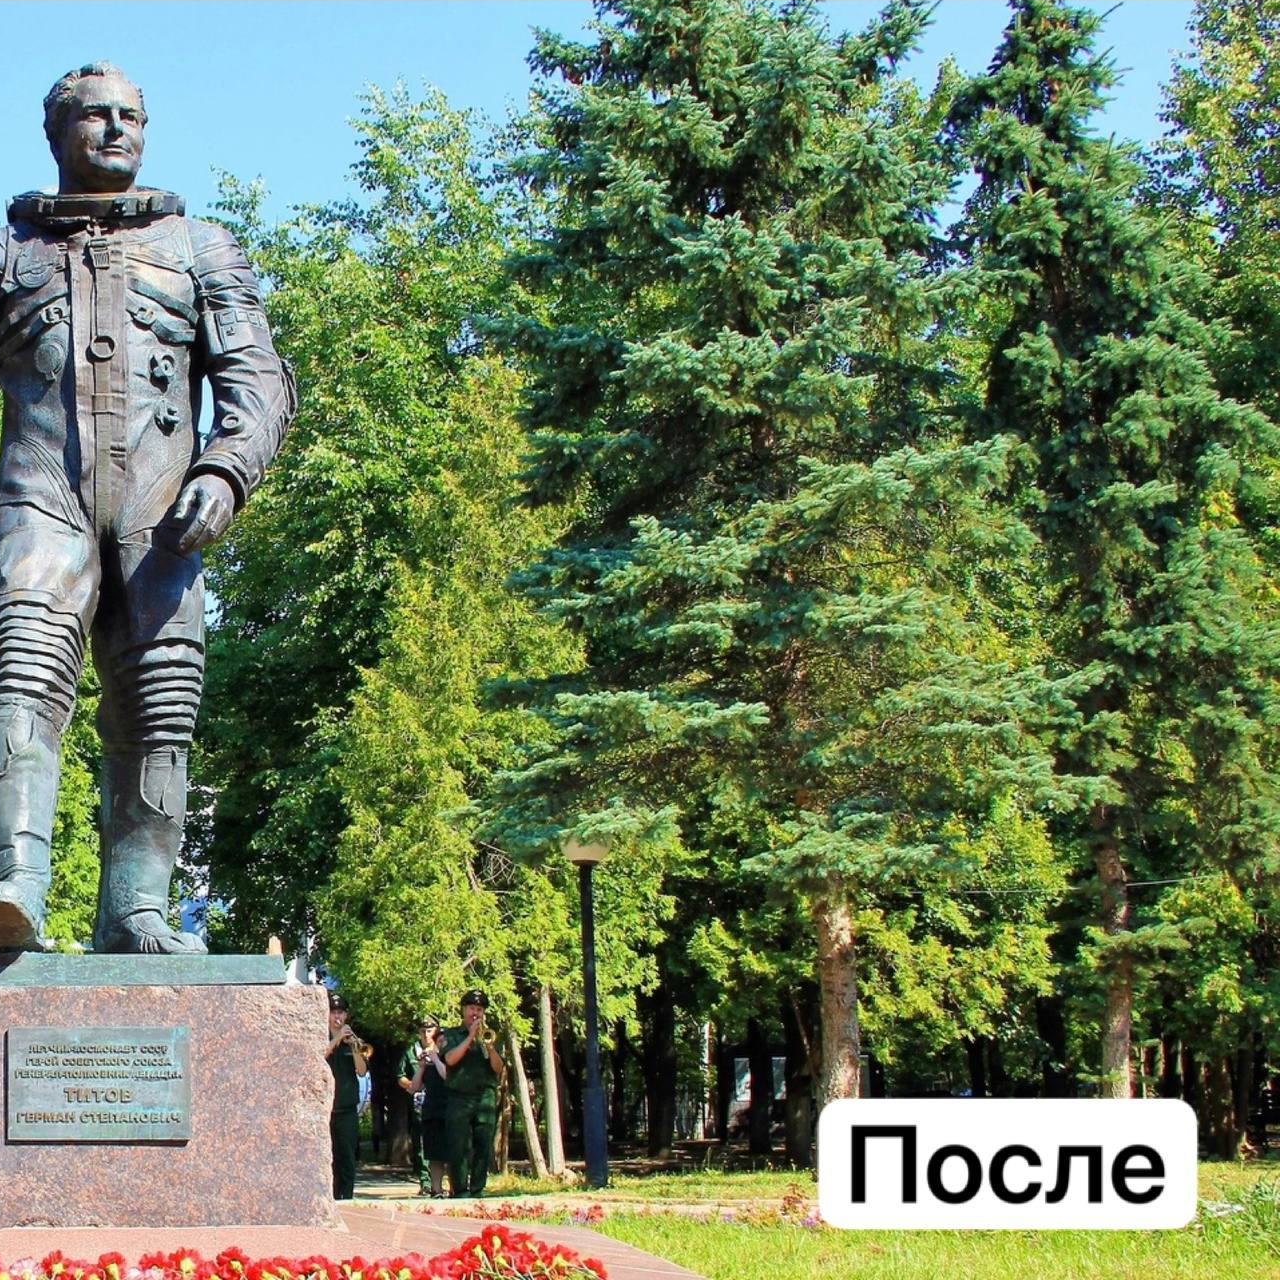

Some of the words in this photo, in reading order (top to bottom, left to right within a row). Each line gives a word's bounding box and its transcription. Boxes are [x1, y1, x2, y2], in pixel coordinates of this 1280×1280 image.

[25, 1056, 59, 1067] ГЕРОЙ
[64, 1087, 134, 1103] ТИТОВ
[16, 1111, 76, 1124] ГЕРМАН
[79, 1111, 182, 1124] СТЕПАНОВИЧ
